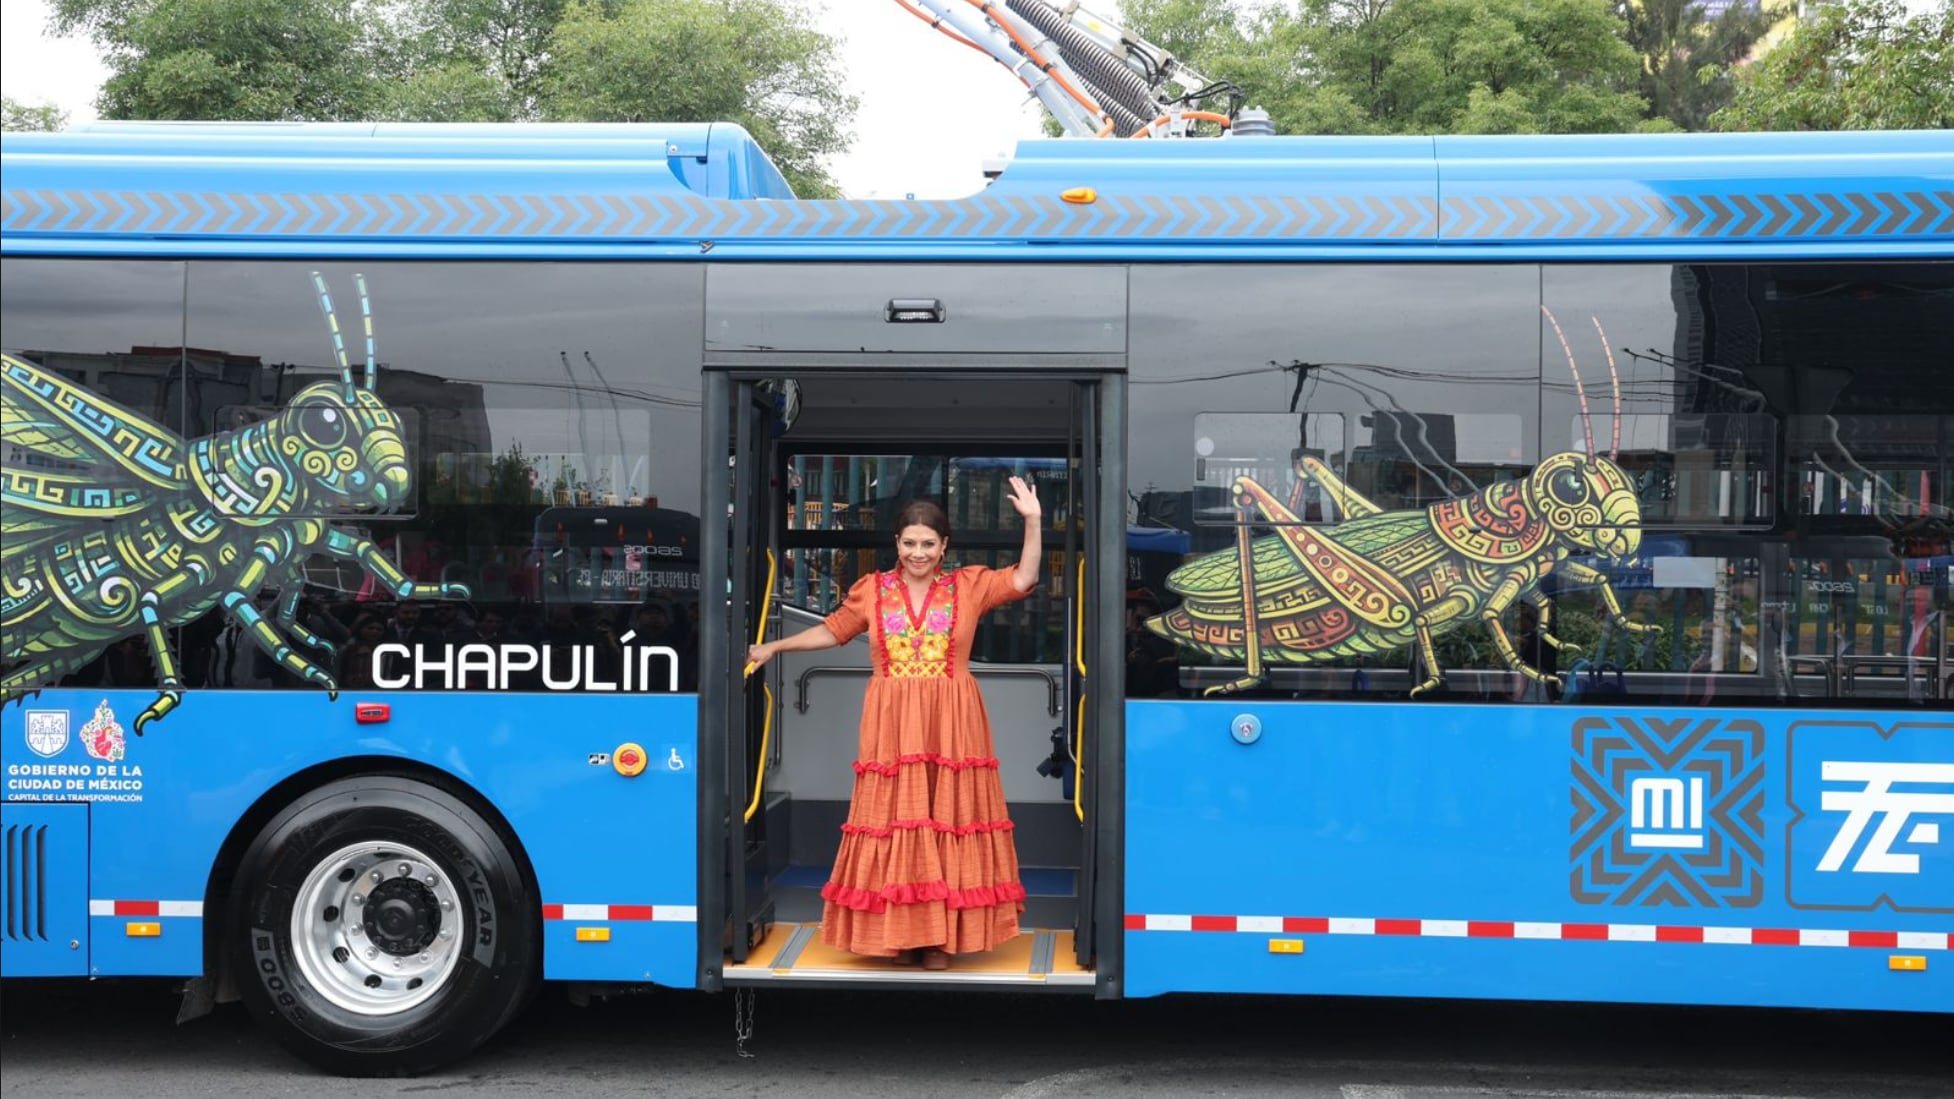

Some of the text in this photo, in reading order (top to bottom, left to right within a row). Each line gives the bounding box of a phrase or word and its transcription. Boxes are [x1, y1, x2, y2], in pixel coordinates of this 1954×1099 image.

[8, 764, 143, 777] GOBIERNO DE LA
[8, 777, 143, 790] CIUDAD DE MÉXICO
[67, 793, 143, 802] TRANSFORMACIÓN
